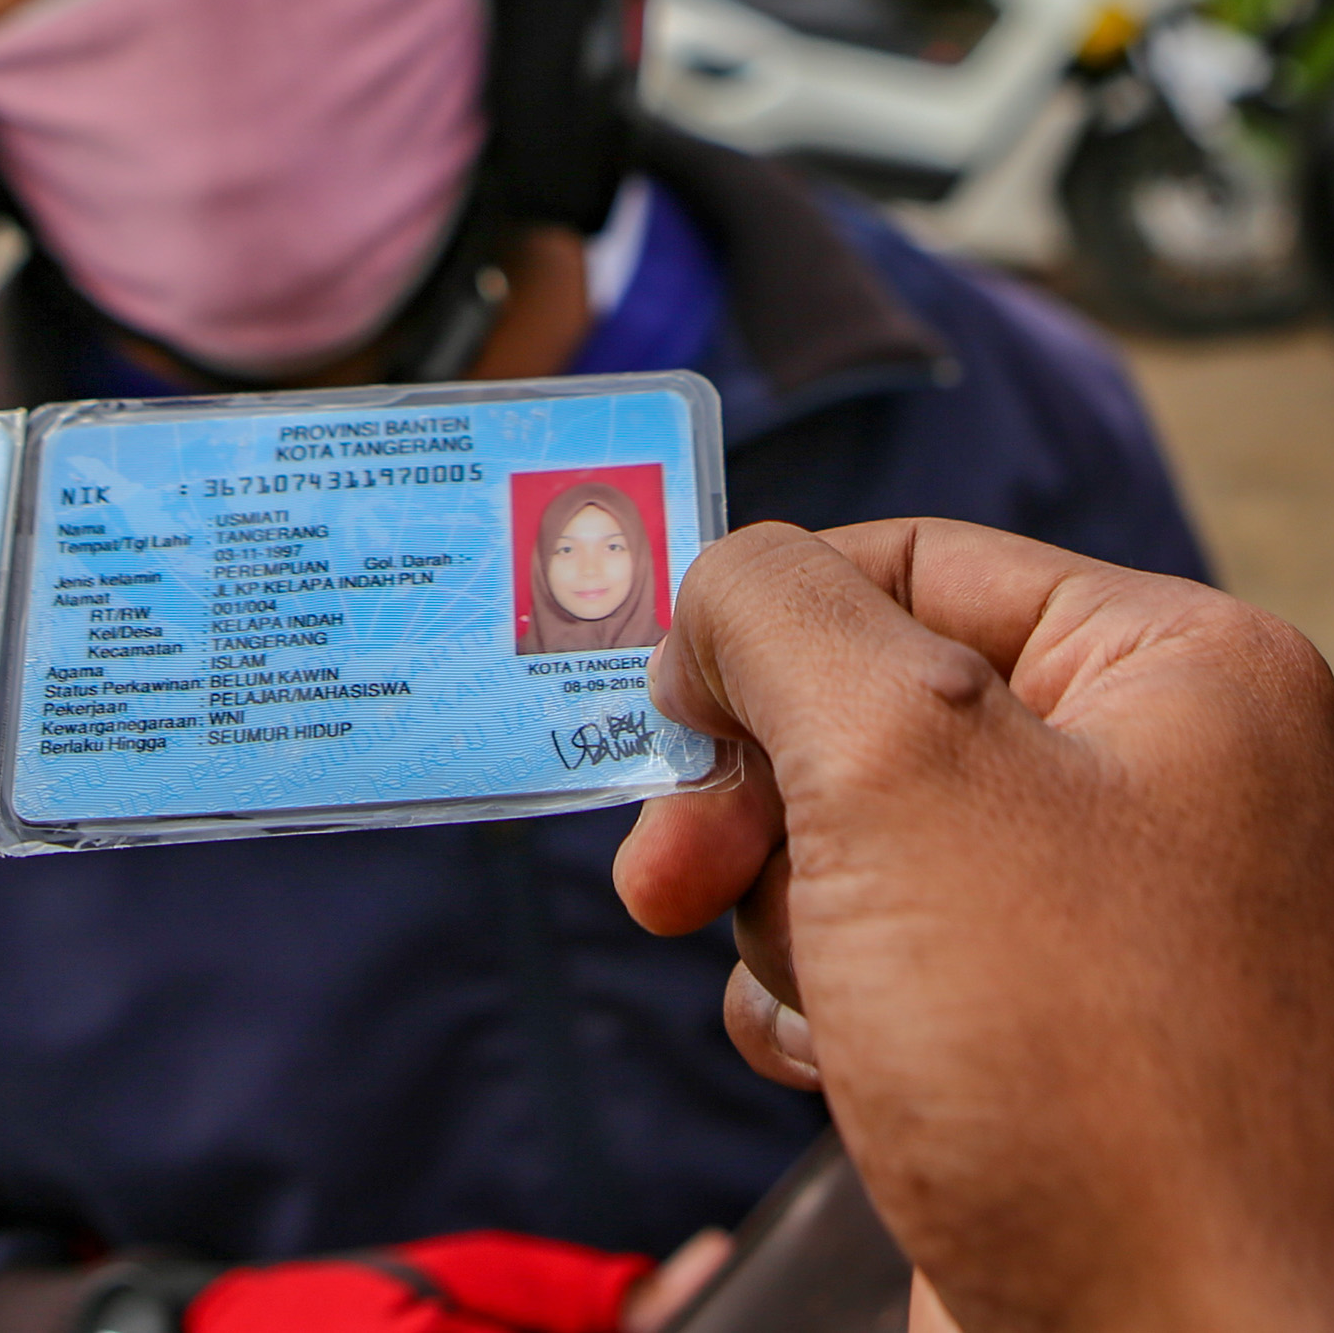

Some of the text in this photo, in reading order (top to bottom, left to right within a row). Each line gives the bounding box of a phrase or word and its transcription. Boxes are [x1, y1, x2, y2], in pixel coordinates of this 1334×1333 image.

[279, 416, 470, 442] PROVINSI BANTEN
[275, 436, 473, 461] KOTA TANGERANG
[61, 486, 110, 505] NIK
[203, 463, 483, 498] 3671074311970005
[58, 510, 289, 536] Nama USMIATI
[217, 525, 329, 544] TANGERANG
[214, 544, 303, 562] 03-11-1997
[55, 575, 95, 590] Jenis
[100, 572, 161, 586] kelamin
[214, 560, 329, 578] PEREMPUAN
[401, 554, 453, 568] Darah
[53, 572, 433, 606] Alamat JL KP KELAPA INDAH PLN
[91, 600, 277, 622] RT/RW 001/004
[89, 613, 343, 640] Kel/Desa KELAPA INDAH
[87, 632, 327, 659] Kecamatan TANGERANG
[46, 654, 265, 682] Agama ISLAM
[528, 661, 573, 676] KOTA
[44, 684, 97, 698] Status
[210, 672, 273, 688] BELUM
[278, 668, 339, 684] KAWIN
[563, 677, 645, 693] 08-09-2016
[43, 682, 411, 717] Pekerjaan PELAJAR/MAHASISWA
[209, 710, 245, 726] WNI
[40, 722, 352, 755] Berlaku Hingga SEUMUR HIDUP
